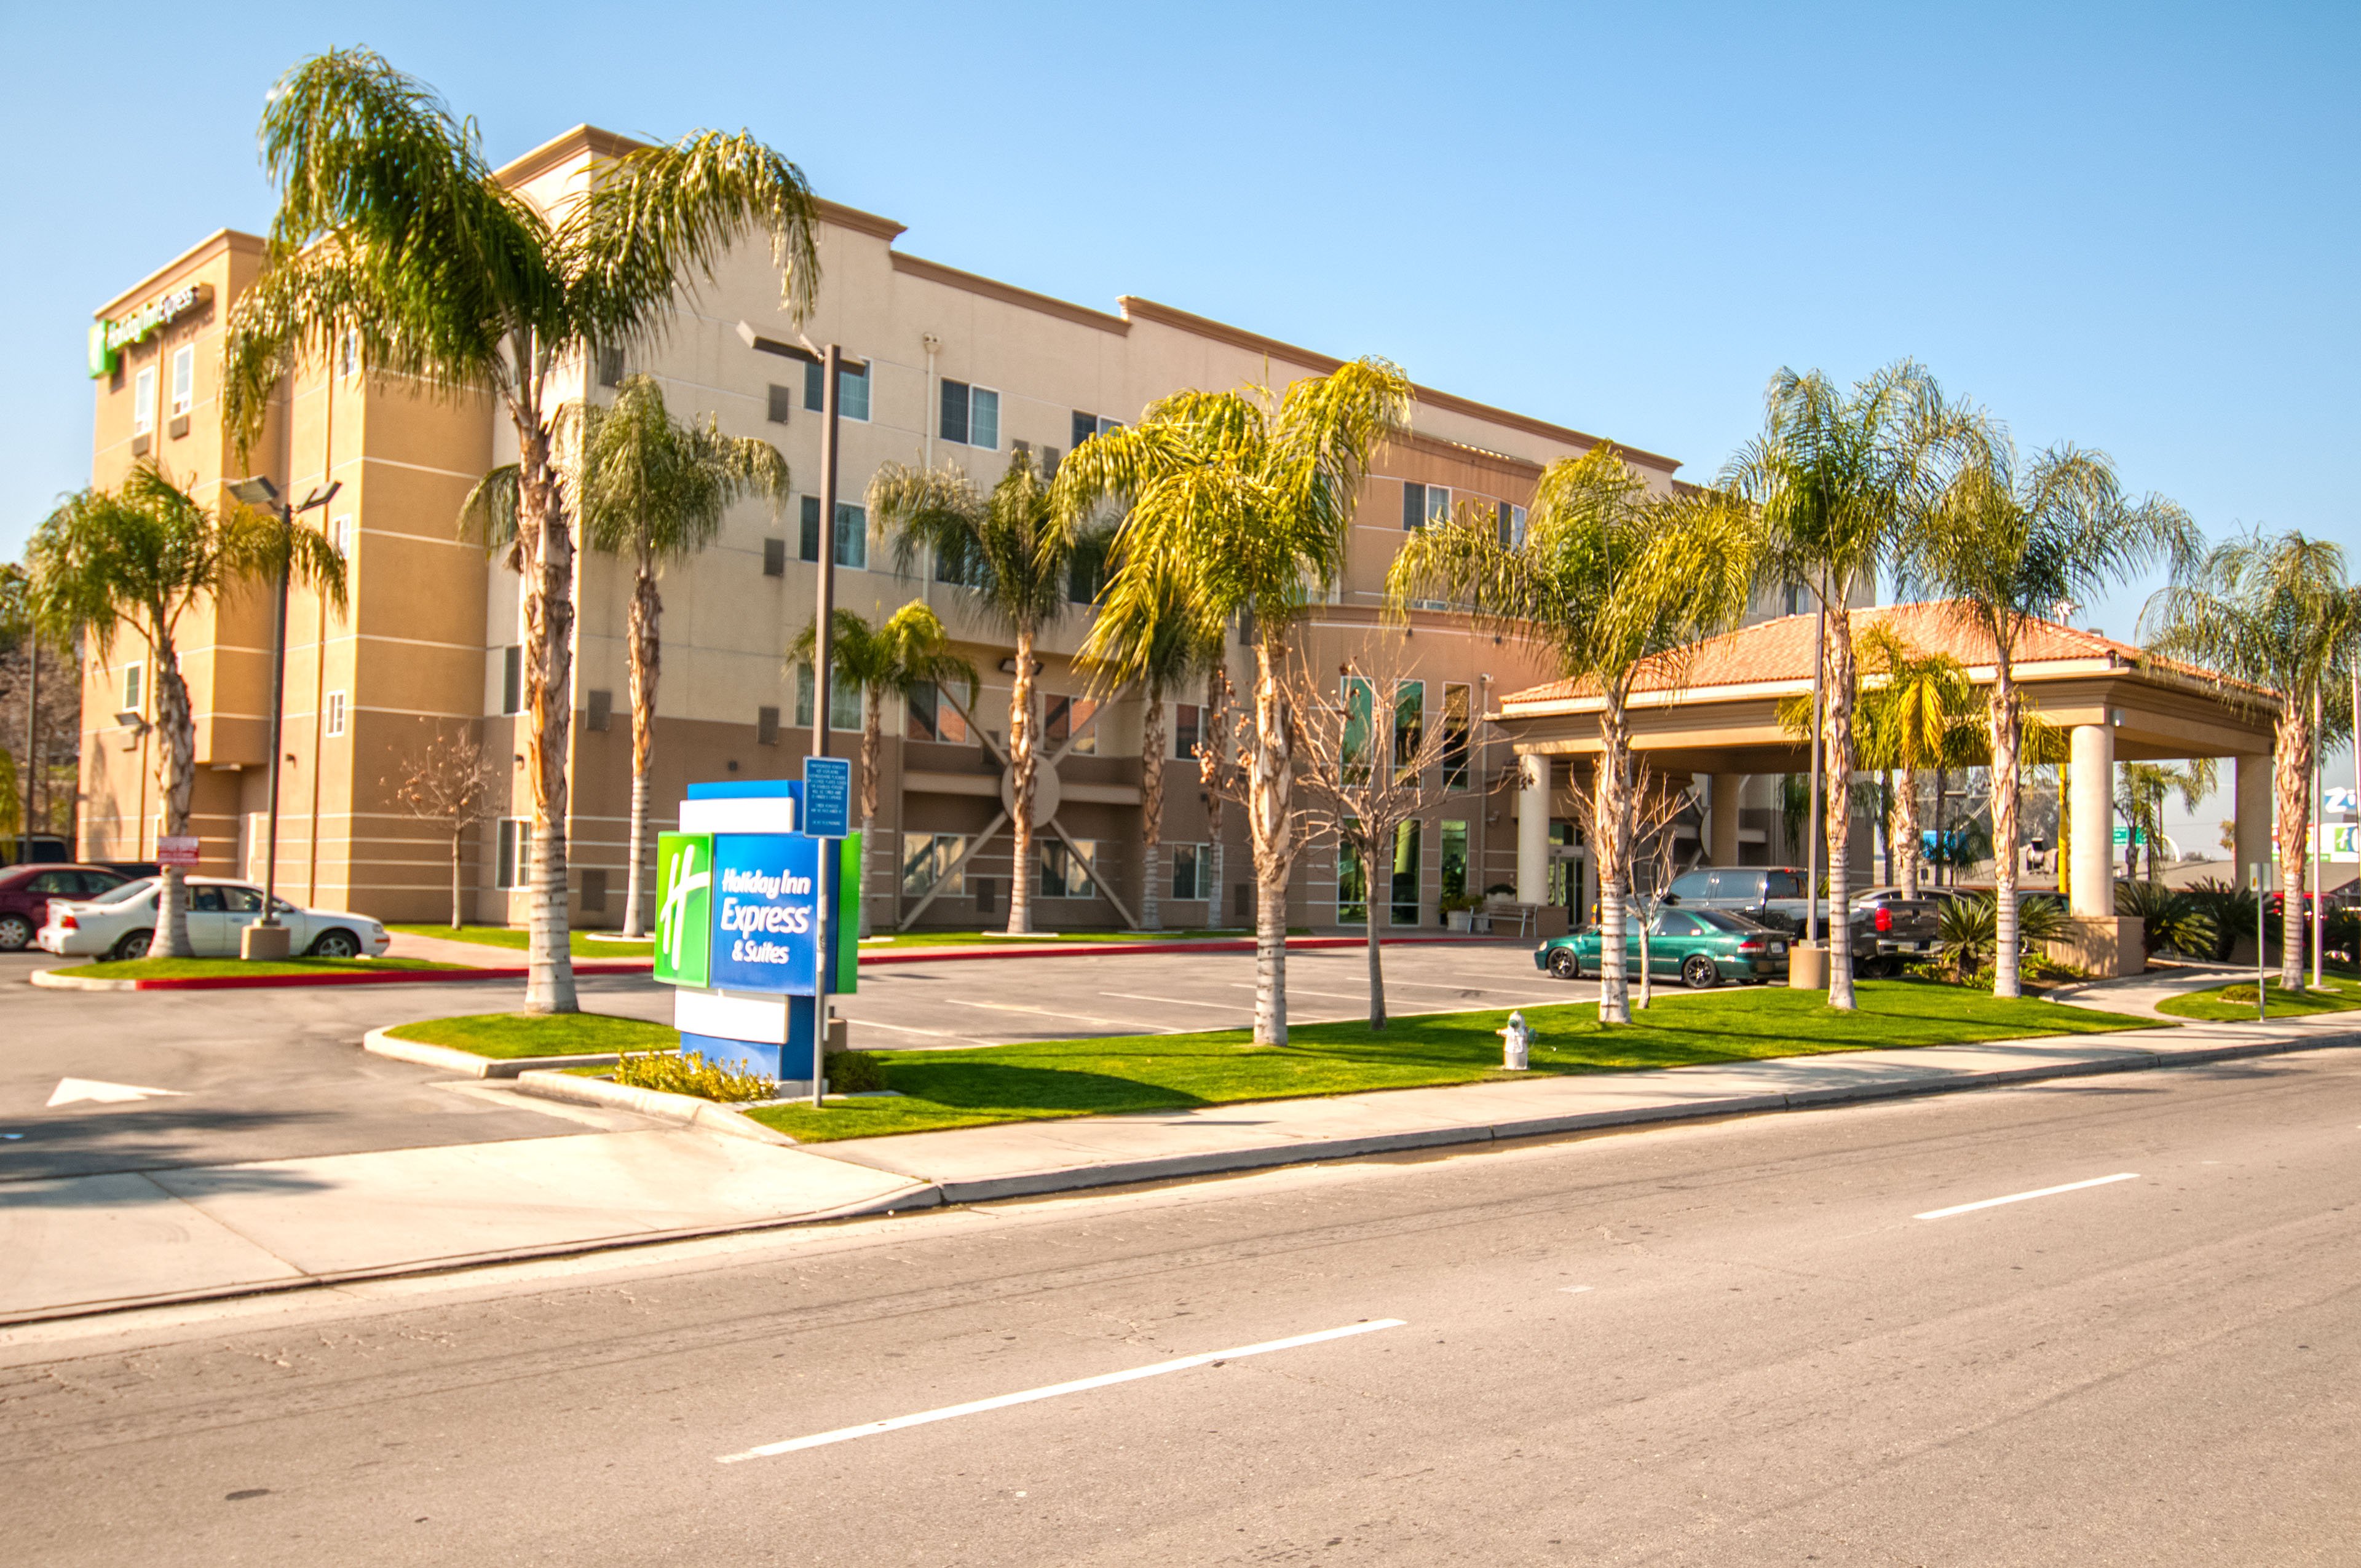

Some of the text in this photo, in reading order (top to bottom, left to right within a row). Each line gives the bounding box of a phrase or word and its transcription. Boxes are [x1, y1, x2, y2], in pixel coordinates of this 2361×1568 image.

[722, 868, 812, 899] Holiday Inn
[721, 897, 810, 940] Express
[732, 939, 790, 964] & Suites
